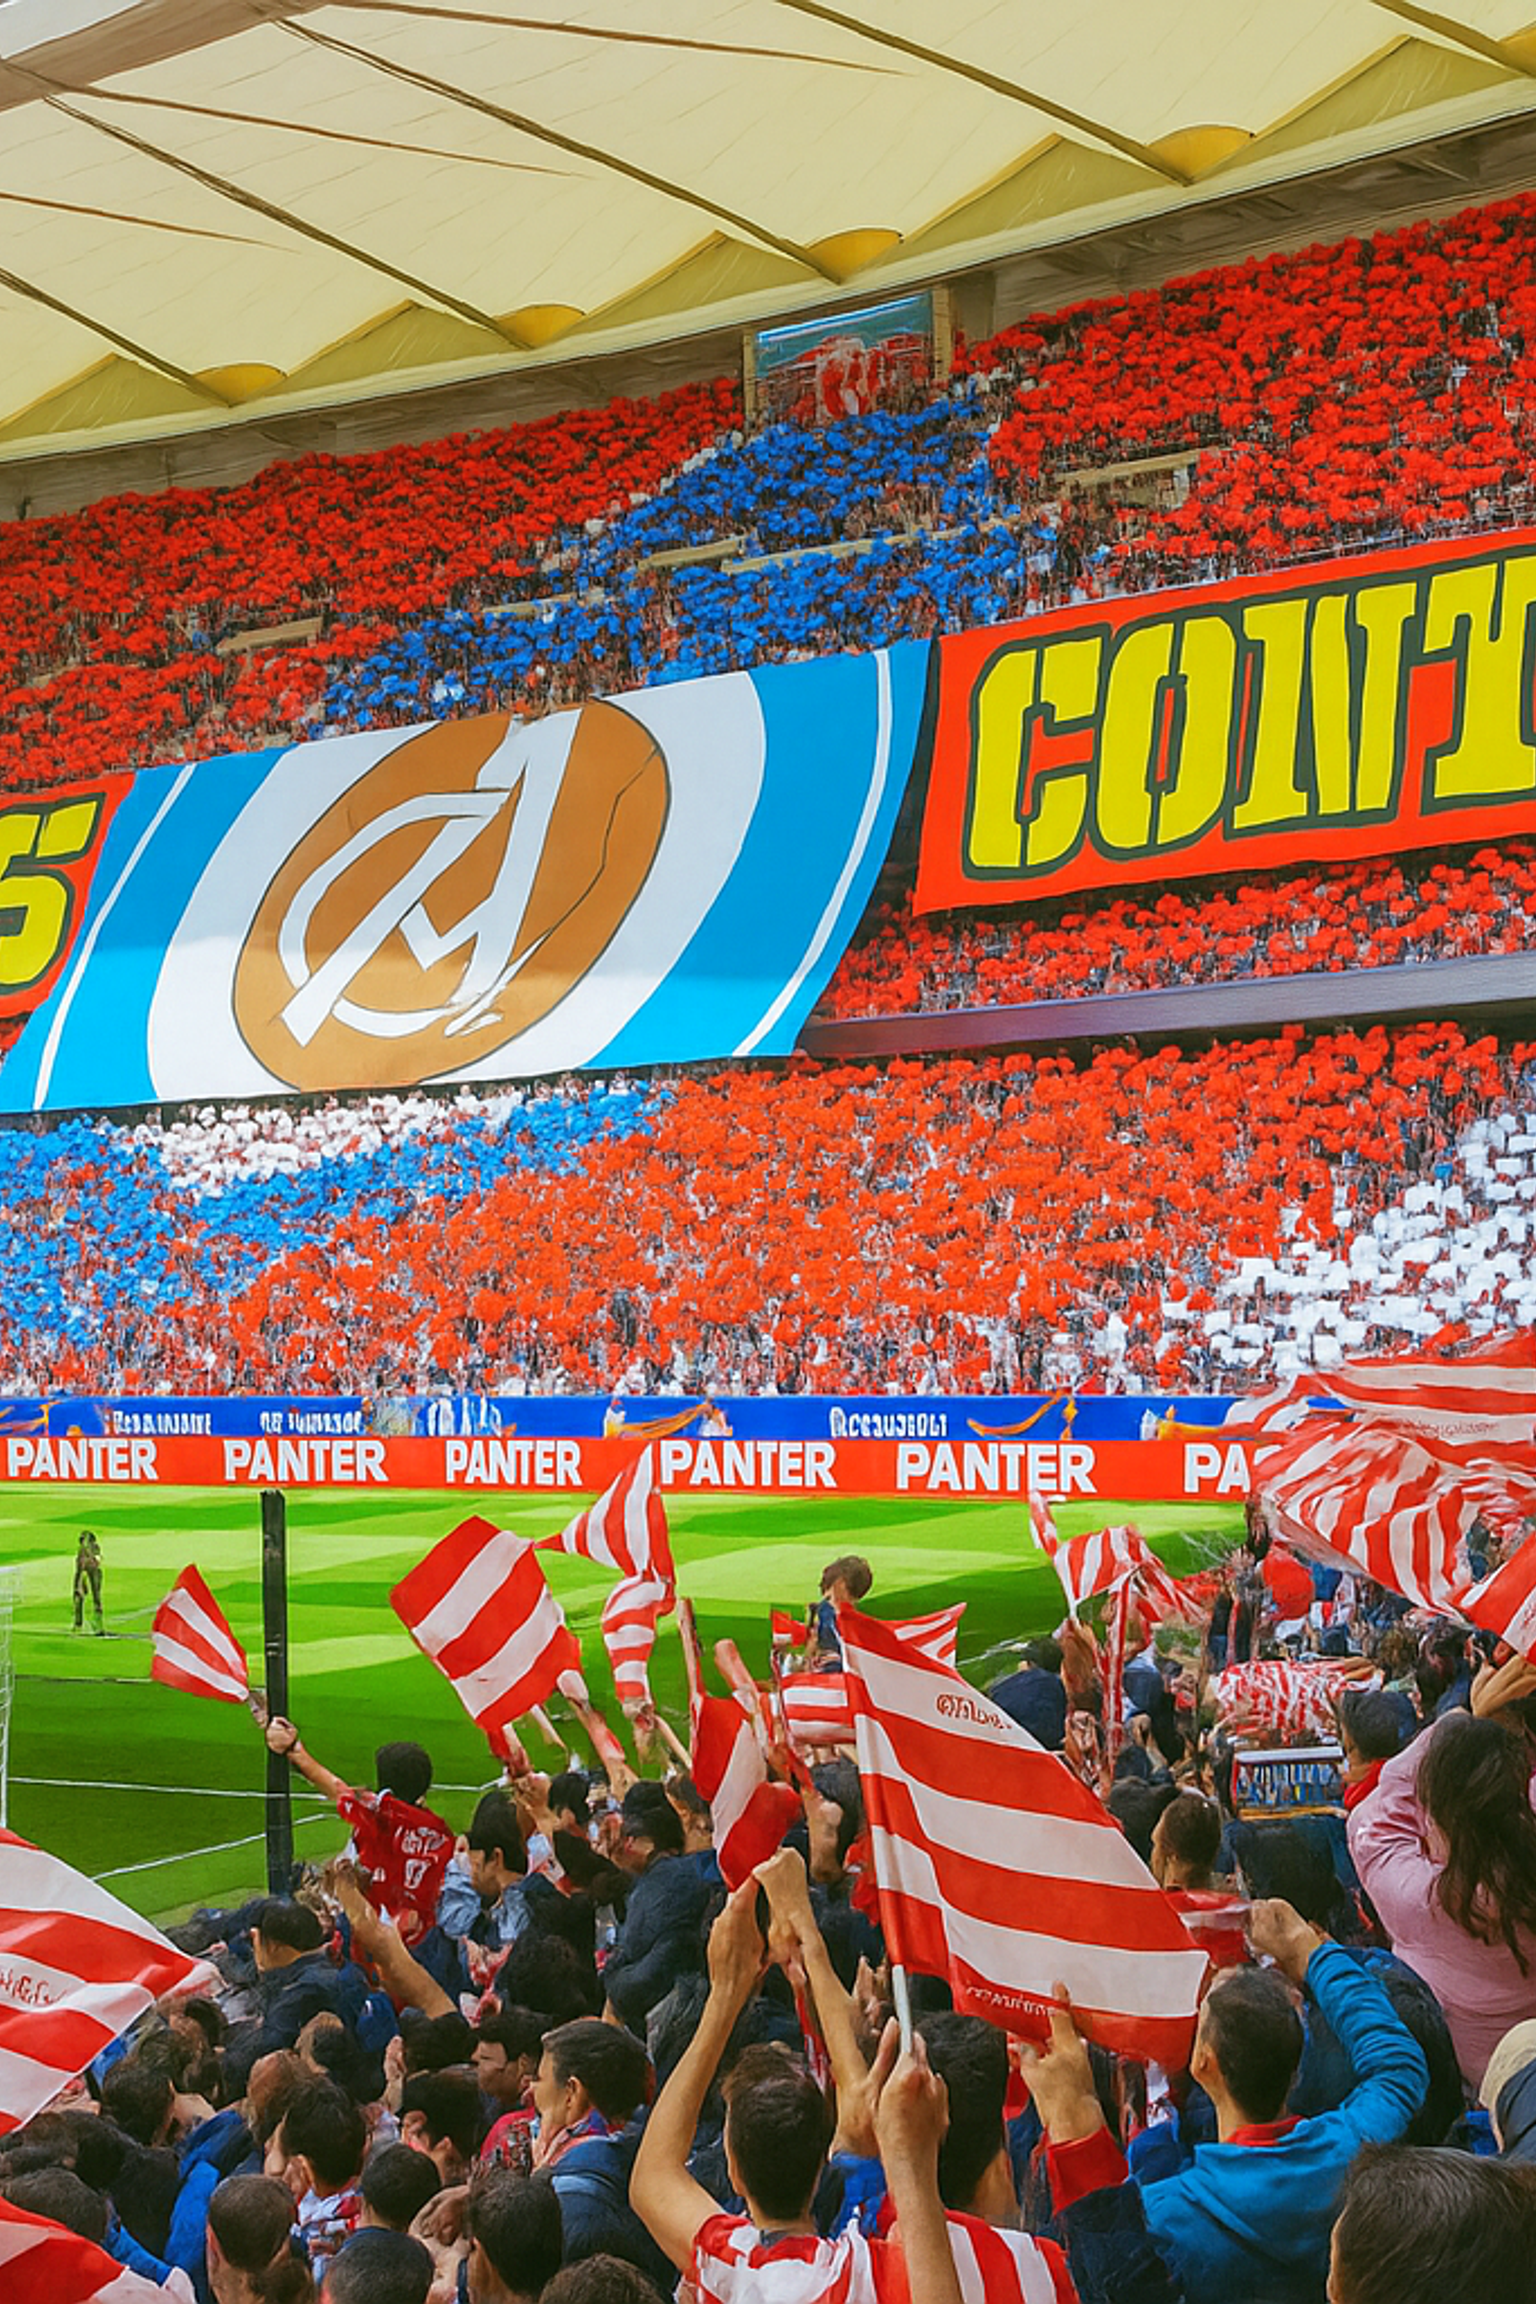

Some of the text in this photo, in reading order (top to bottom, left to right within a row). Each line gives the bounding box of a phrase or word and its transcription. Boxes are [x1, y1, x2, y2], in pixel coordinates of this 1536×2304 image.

[966, 549, 1536, 874] CONT
[7, 1437, 159, 1480] PANTER
[223, 1439, 389, 1482] PANTER
[444, 1440, 582, 1486] PANTER
[660, 1439, 838, 1488] PANTER
[896, 1442, 1097, 1493] PANTER
